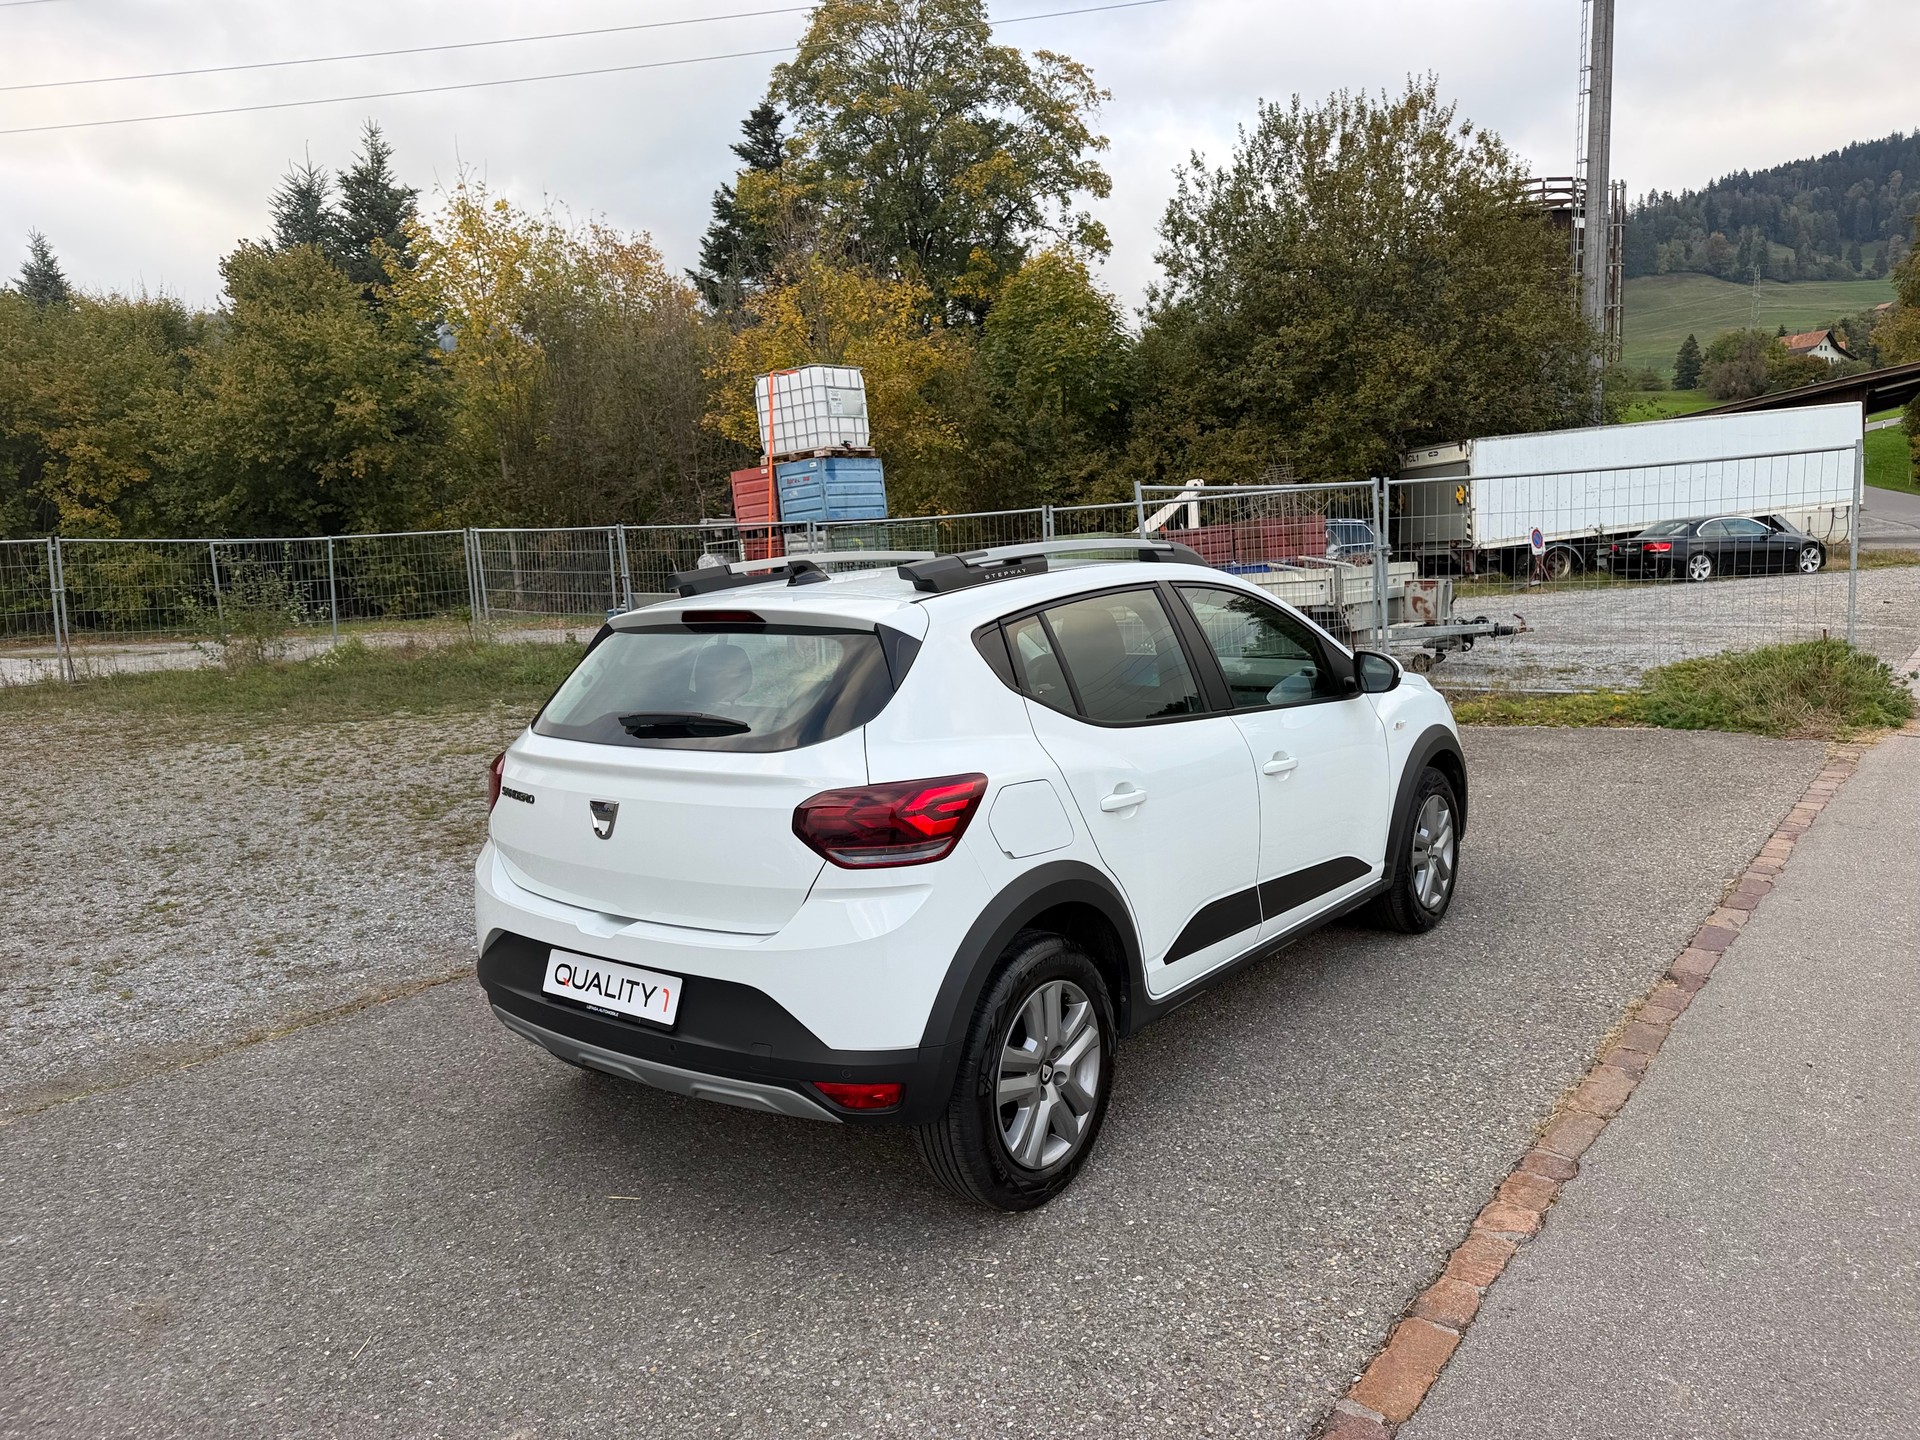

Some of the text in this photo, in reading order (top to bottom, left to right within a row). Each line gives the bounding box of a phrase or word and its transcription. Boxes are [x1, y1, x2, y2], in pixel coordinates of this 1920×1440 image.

[984, 567, 1027, 580] STEPWAY
[501, 786, 535, 804] SANDERO
[554, 963, 670, 1013] QUALITY 1
